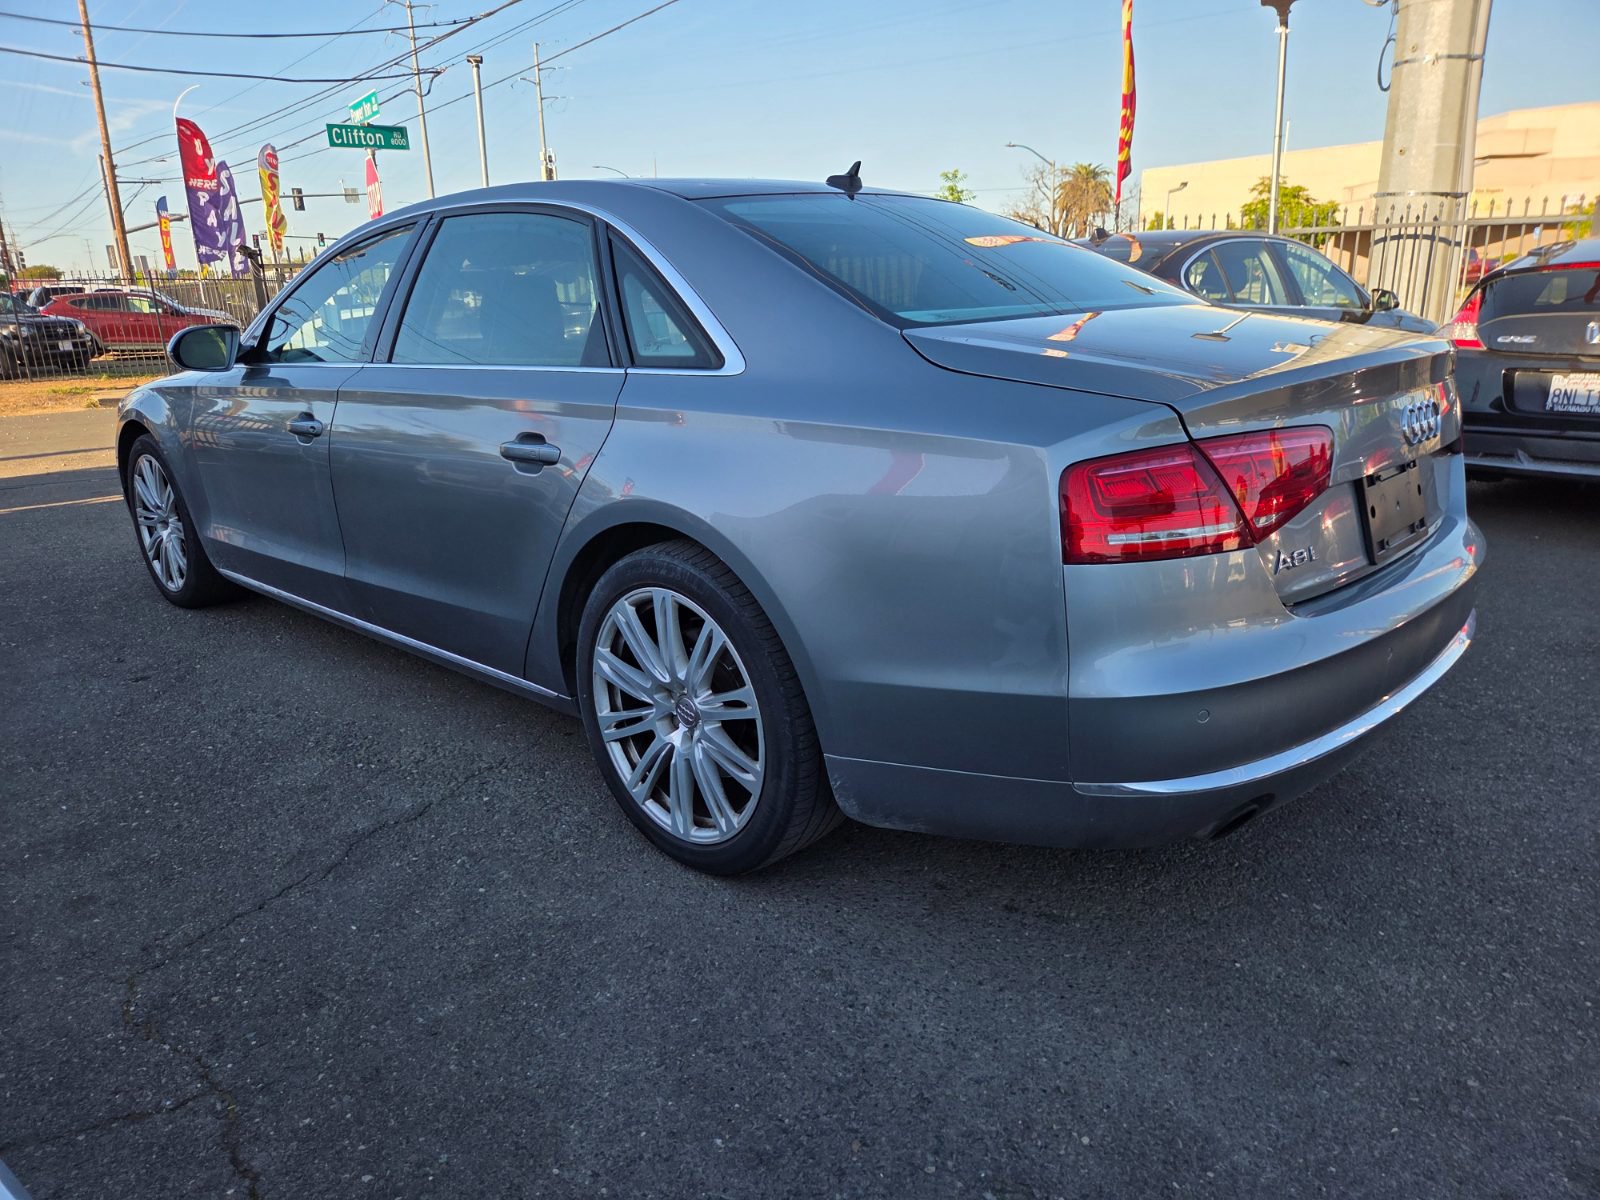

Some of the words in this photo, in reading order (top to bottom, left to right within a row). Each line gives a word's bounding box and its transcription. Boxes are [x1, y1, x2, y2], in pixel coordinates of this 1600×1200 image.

[332, 127, 385, 146] Clifton
[189, 178, 217, 190] HERE
[197, 191, 227, 247] PAY
[219, 169, 245, 271] SALE
[161, 218, 172, 265] BUY
[1551, 388, 1600, 406] 8NLT
[1273, 545, 1319, 575] A8L
